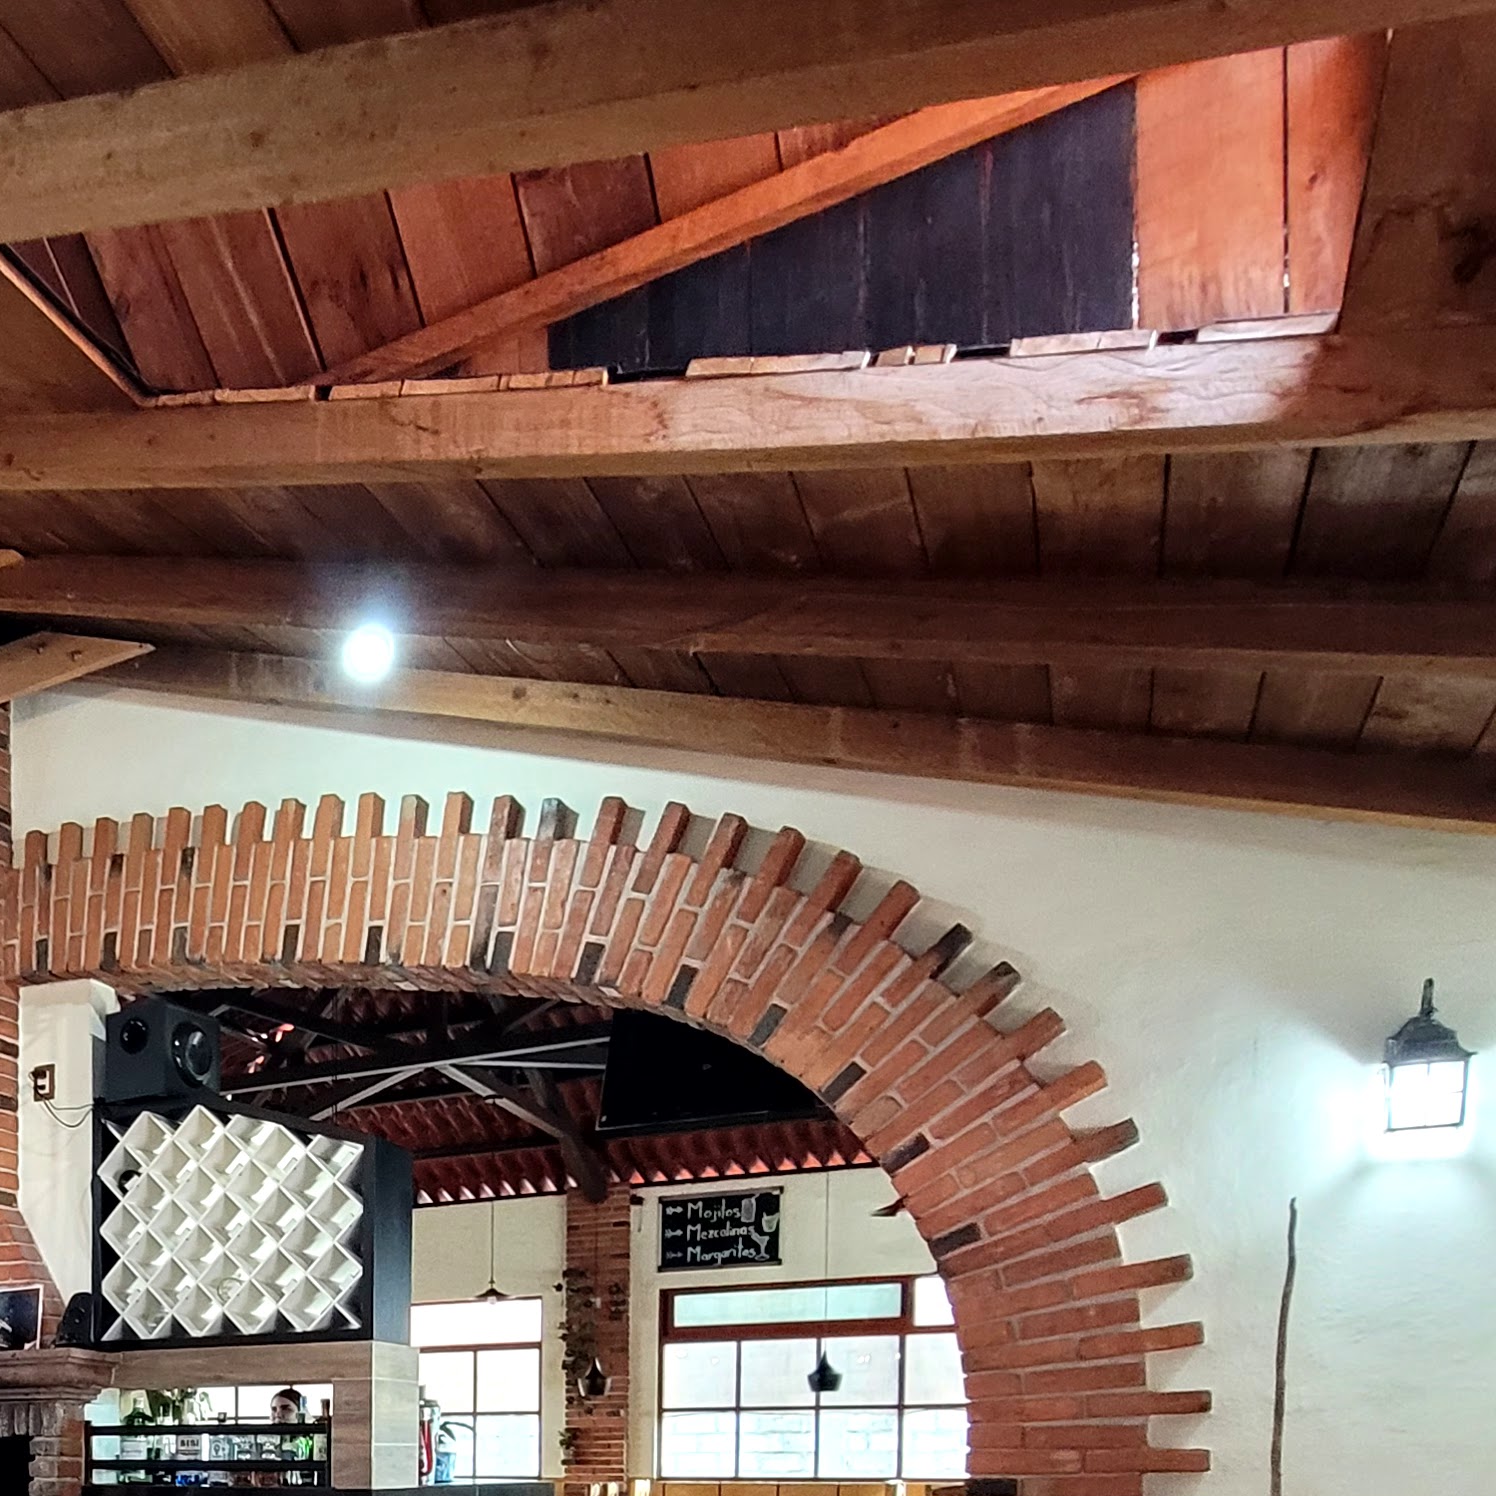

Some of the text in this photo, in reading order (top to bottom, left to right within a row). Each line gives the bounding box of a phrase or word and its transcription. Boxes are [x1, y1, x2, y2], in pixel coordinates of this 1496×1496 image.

[687, 1198, 741, 1223] Mojitos
[686, 1221, 754, 1241] Mezcalinas
[686, 1236, 756, 1264] Margaritas
